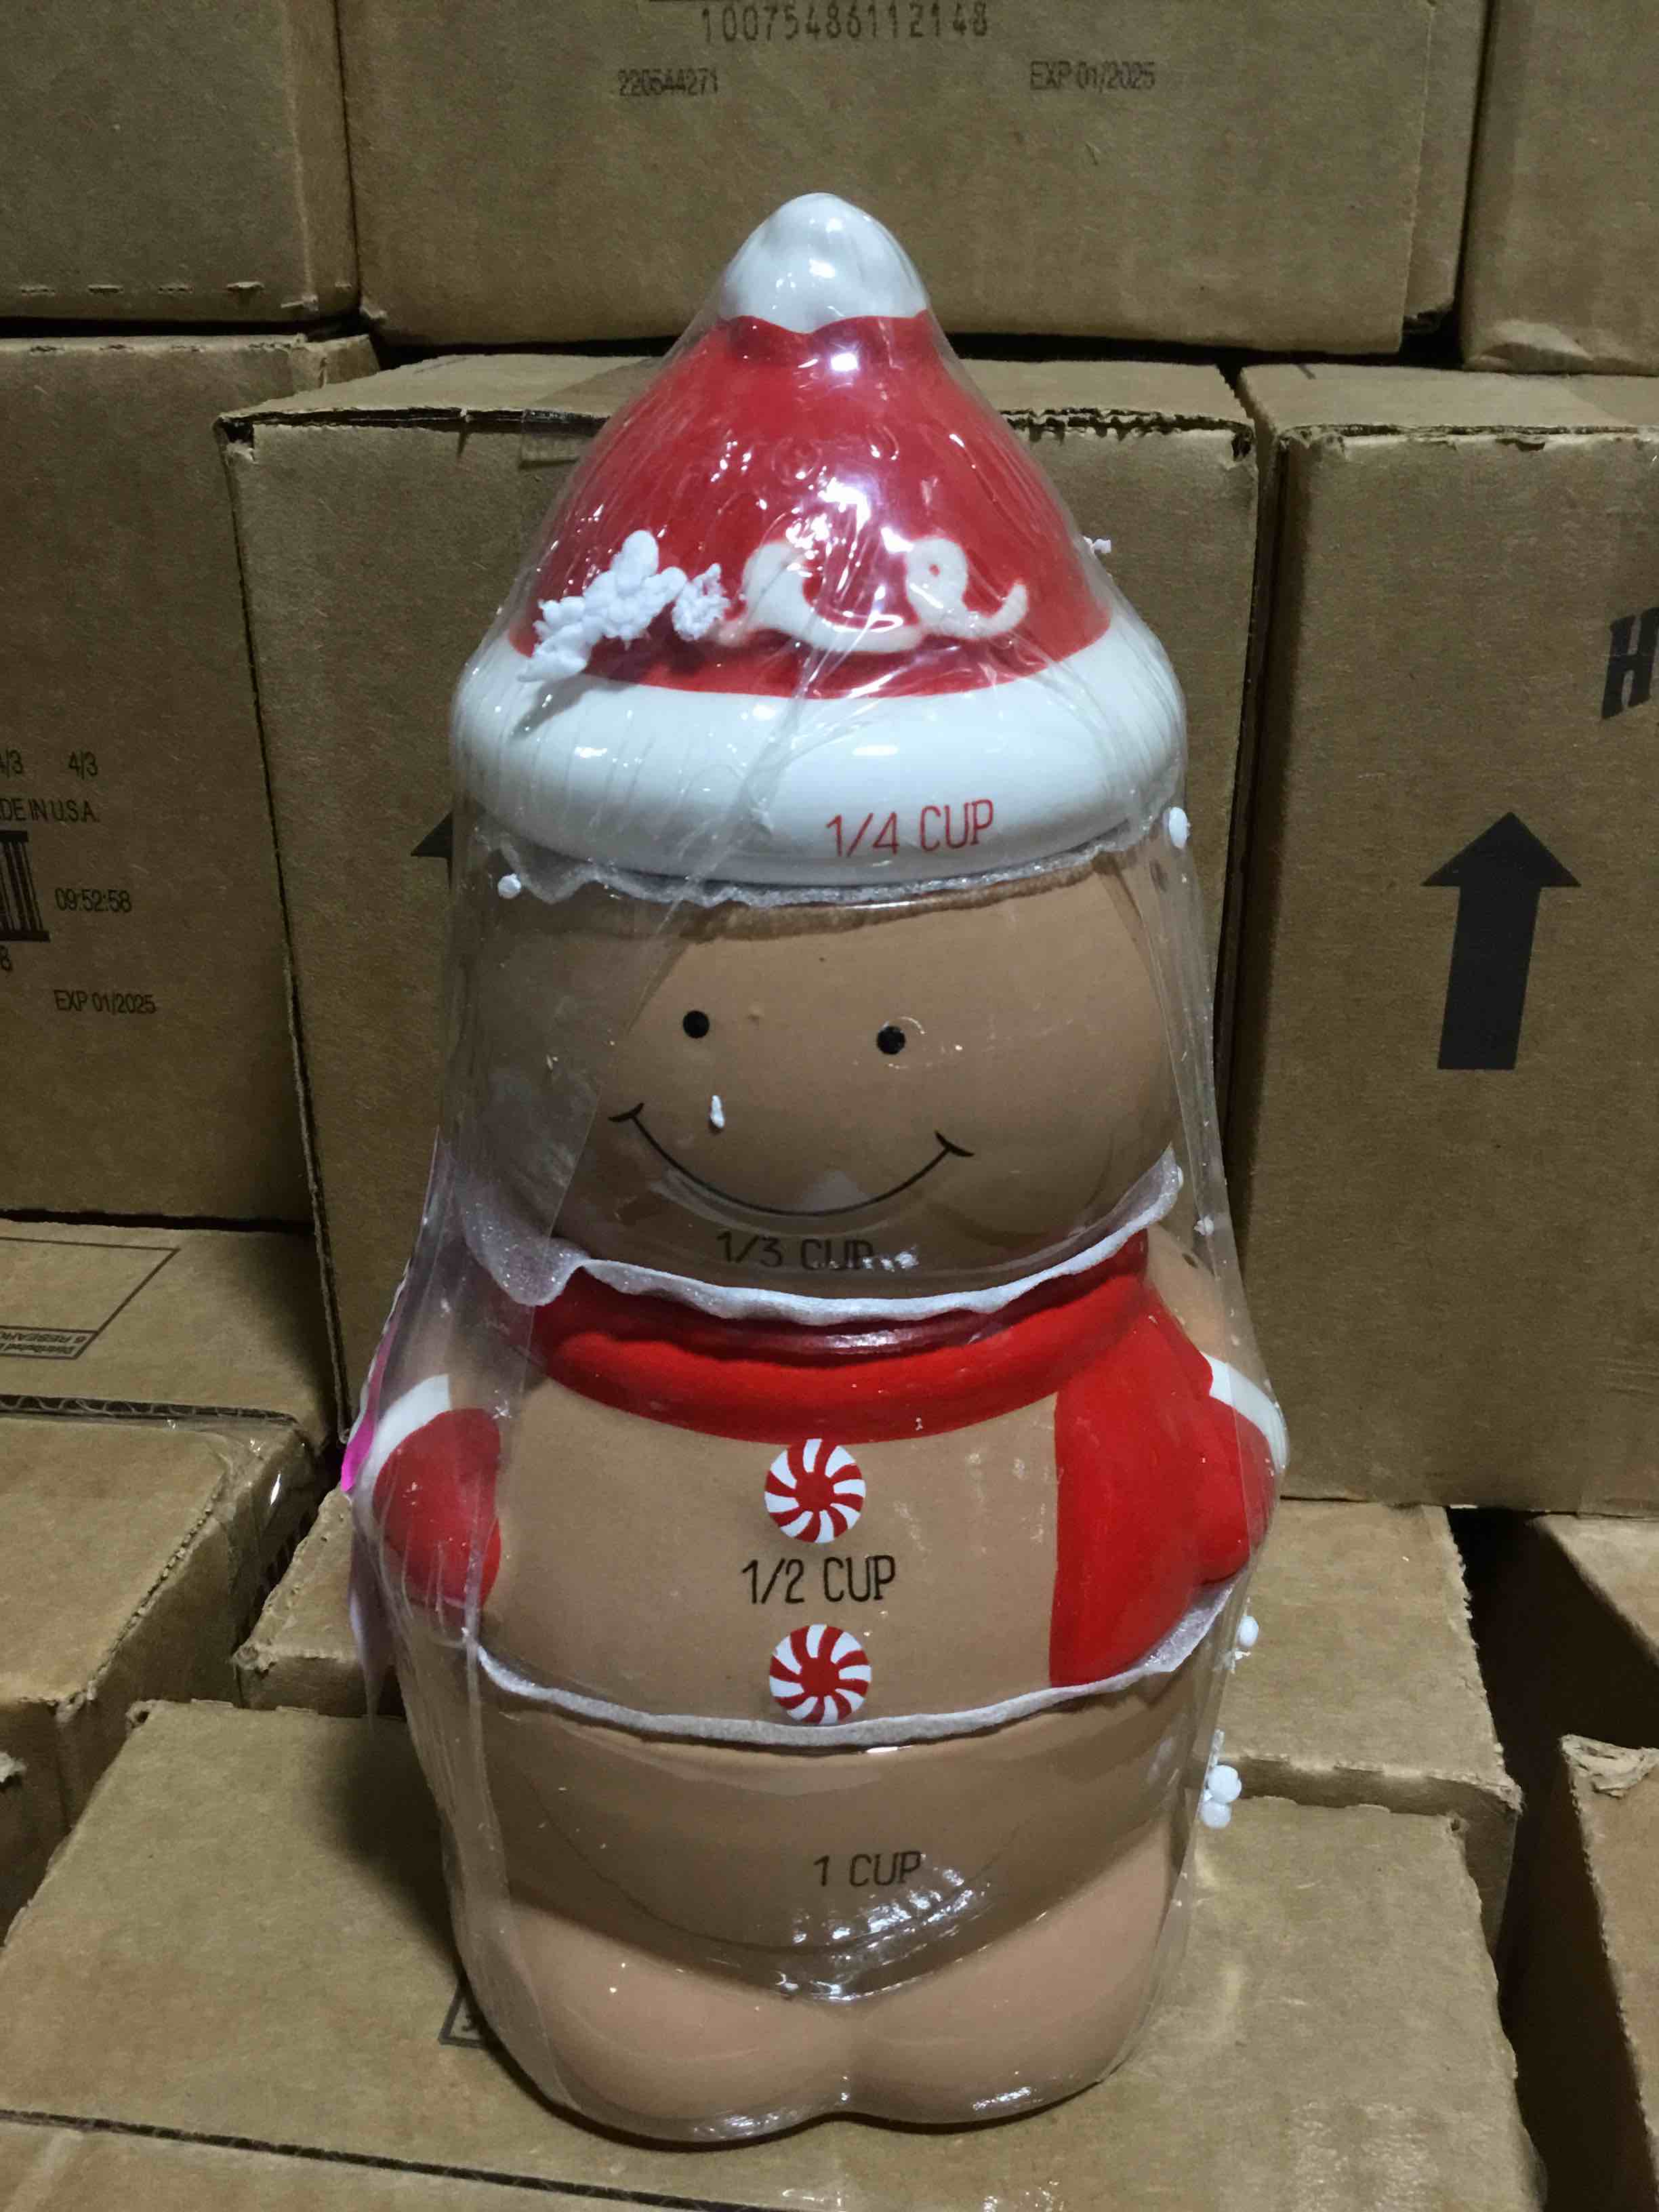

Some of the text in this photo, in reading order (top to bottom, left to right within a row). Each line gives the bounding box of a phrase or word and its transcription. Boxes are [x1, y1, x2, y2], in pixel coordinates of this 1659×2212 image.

[702, 2, 988, 42] 10075486112148
[1030, 60, 1155, 94] EXP 01/2025
[68, 751, 98, 780] 4/3
[28, 799, 49, 822] IN
[825, 799, 994, 857] 1/4 CUP
[55, 888, 133, 912] 09:52:58
[54, 990, 157, 1015] EXP 01/2025
[717, 1230, 874, 1271] 1/3 CUP
[741, 1555, 895, 1604] 1/2 CUP
[813, 1850, 922, 1887] 1 CUP
